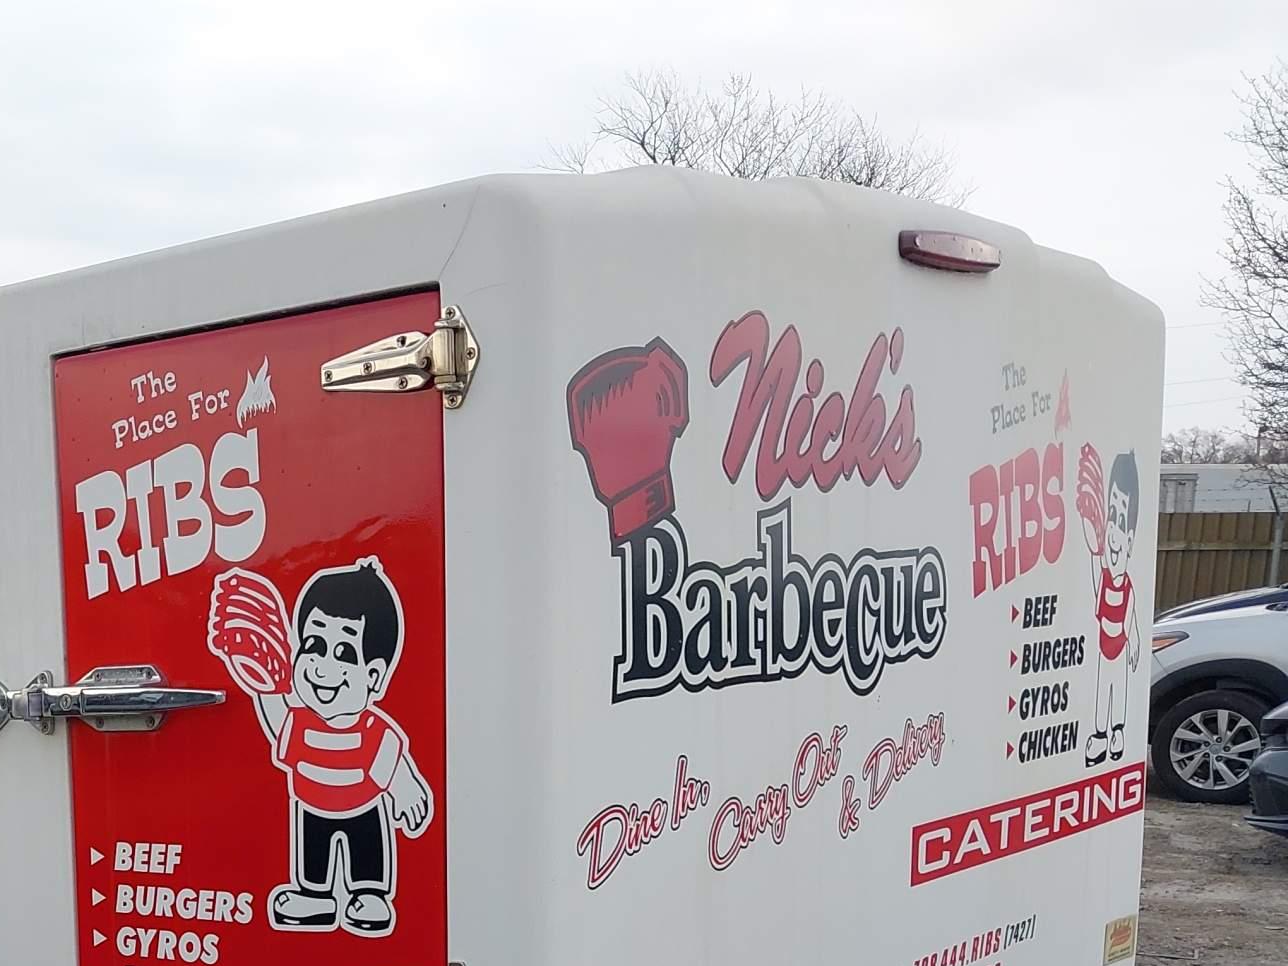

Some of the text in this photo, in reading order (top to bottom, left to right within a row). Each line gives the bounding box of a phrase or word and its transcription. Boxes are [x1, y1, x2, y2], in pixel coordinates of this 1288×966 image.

[131, 369, 177, 404] The
[1001, 361, 1026, 391] The
[112, 387, 230, 449] Place For
[710, 309, 922, 502] Nick's
[991, 391, 1051, 434] Place For
[75, 427, 267, 600] RIBS
[969, 442, 1065, 599] RIBS
[612, 497, 948, 704] Barbecue
[1022, 594, 1058, 629] BEEF
[1021, 635, 1085, 675] BURGERS
[1019, 681, 1069, 721] GYROS
[1018, 720, 1079, 764] CHICKEN
[839, 711, 945, 839] & Delivery
[708, 724, 848, 871] Carry Out
[577, 799, 667, 890] Dine
[917, 770, 1142, 877] CATERING
[114, 841, 183, 874] BEEF
[115, 884, 254, 924] BURGERS
[115, 926, 220, 965] GYROS
